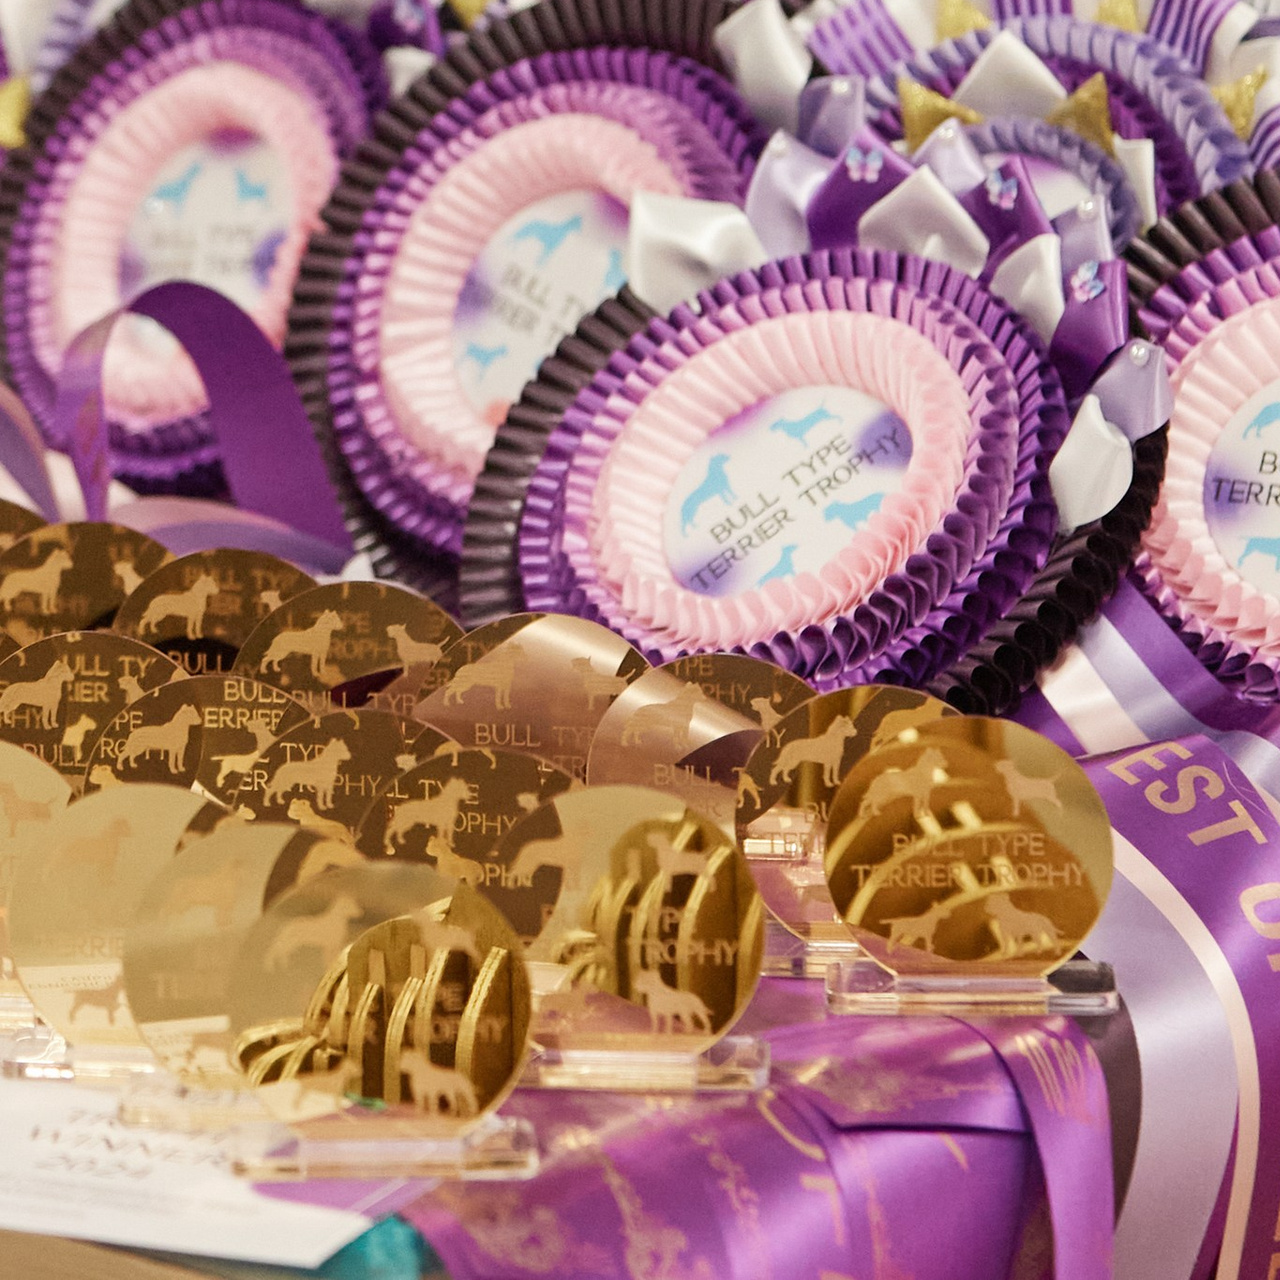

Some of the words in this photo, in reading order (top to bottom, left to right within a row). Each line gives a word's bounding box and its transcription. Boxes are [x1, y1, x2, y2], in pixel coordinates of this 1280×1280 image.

[709, 491, 780, 545] BULL
[781, 434, 852, 488] TYPE
[689, 508, 797, 592] TERRIER
[798, 425, 901, 508] TROPHY
[475, 723, 541, 748] BULL
[980, 833, 1045, 857] TYPE
[851, 864, 961, 888] TERRIER
[978, 863, 1087, 887] TROPHY
